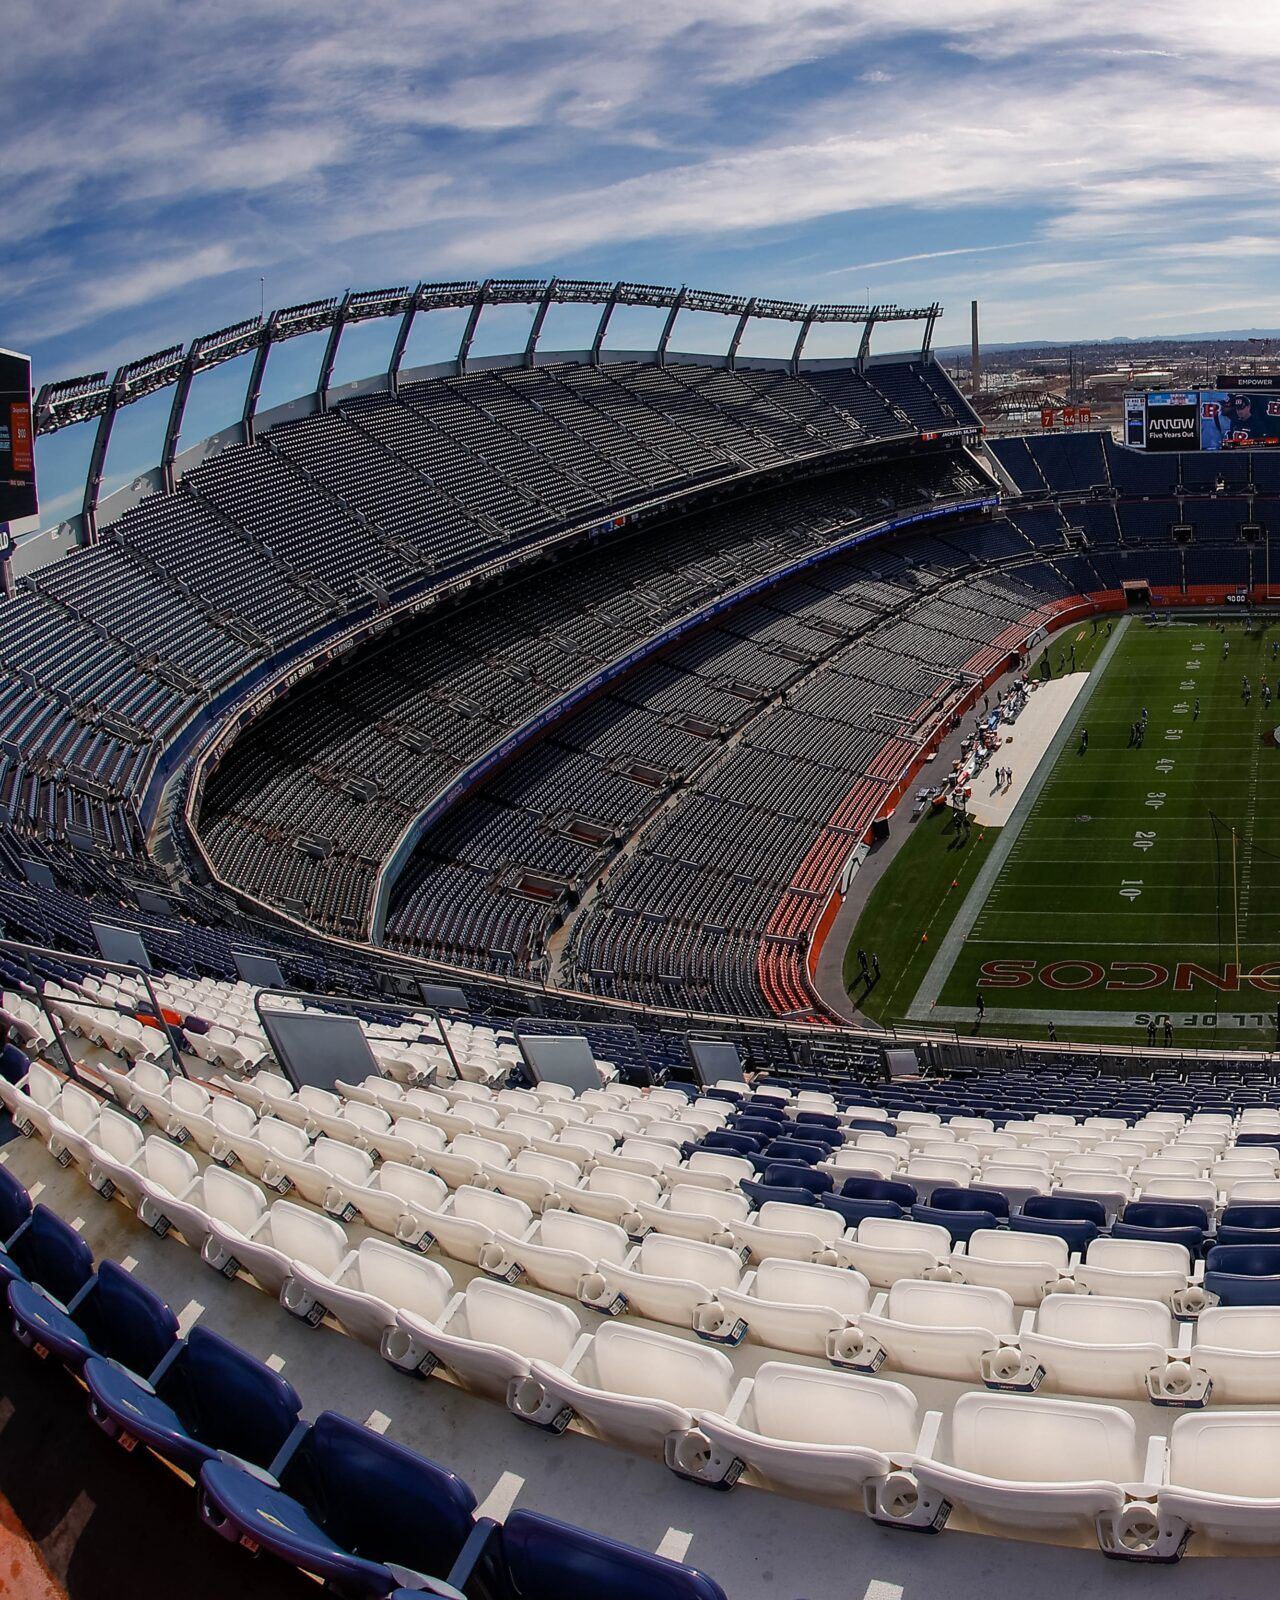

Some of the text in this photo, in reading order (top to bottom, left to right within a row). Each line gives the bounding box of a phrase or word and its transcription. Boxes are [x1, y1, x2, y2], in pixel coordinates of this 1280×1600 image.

[1044, 416, 1050, 425] 7
[1064, 415, 1075, 423] 44
[1080, 414, 1089, 423] 18
[1149, 418, 1195, 430] ARROW
[668, 626, 682, 638] GEICO
[631, 649, 646, 661] GEICO
[298, 661, 316, 677] SMITH
[587, 676, 603, 691] GEICO
[545, 705, 562, 720] GEICO
[1164, 729, 1183, 741] 50
[500, 739, 517, 757] GEICO
[1155, 758, 1175, 771] 40
[446, 783, 464, 803] GEICO
[1145, 792, 1166, 806] 30
[1132, 831, 1156, 848] 20
[1118, 878, 1143, 897] 10
[1135, 1013, 1171, 1027] US
[1183, 1014, 1218, 1026] OF
[1232, 1014, 1279, 1027] ALL
